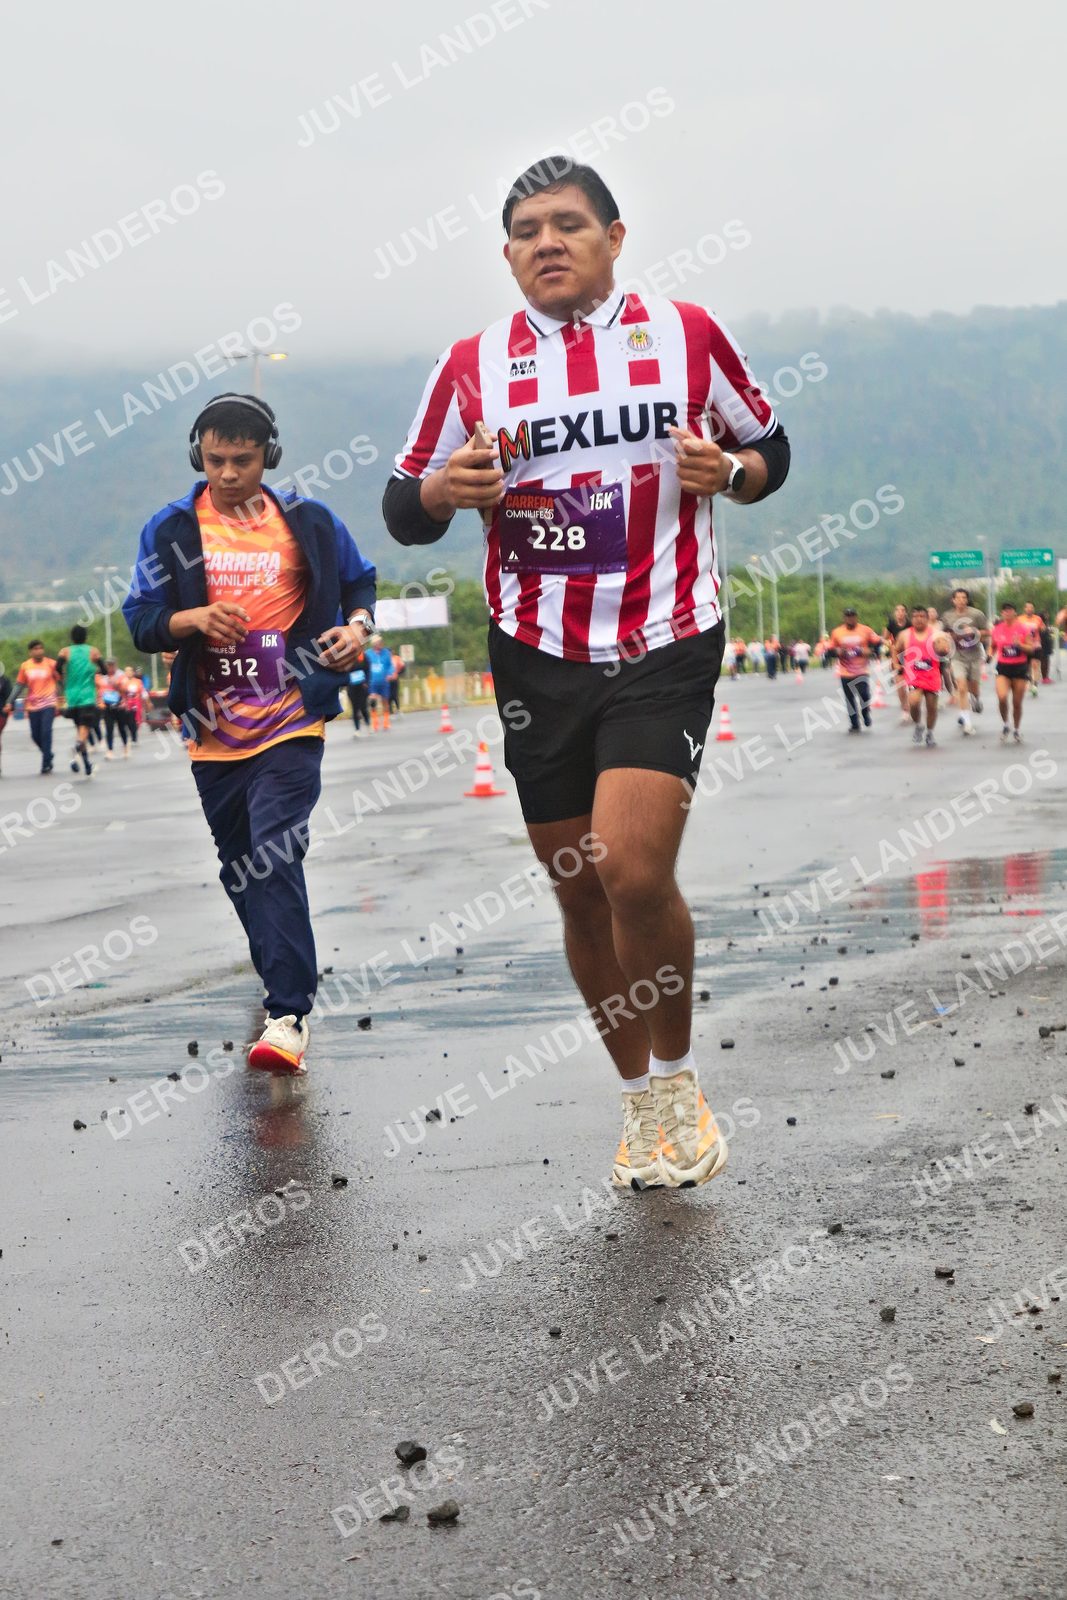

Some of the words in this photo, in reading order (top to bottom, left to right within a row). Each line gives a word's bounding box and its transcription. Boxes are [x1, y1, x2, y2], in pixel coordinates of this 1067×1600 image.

[510, 360, 536, 370] ABA
[498, 402, 679, 472] MEXLUB
[505, 494, 554, 509] CARRERA
[590, 492, 613, 510] 15K
[531, 526, 586, 551] 228
[219, 658, 258, 676] 312
